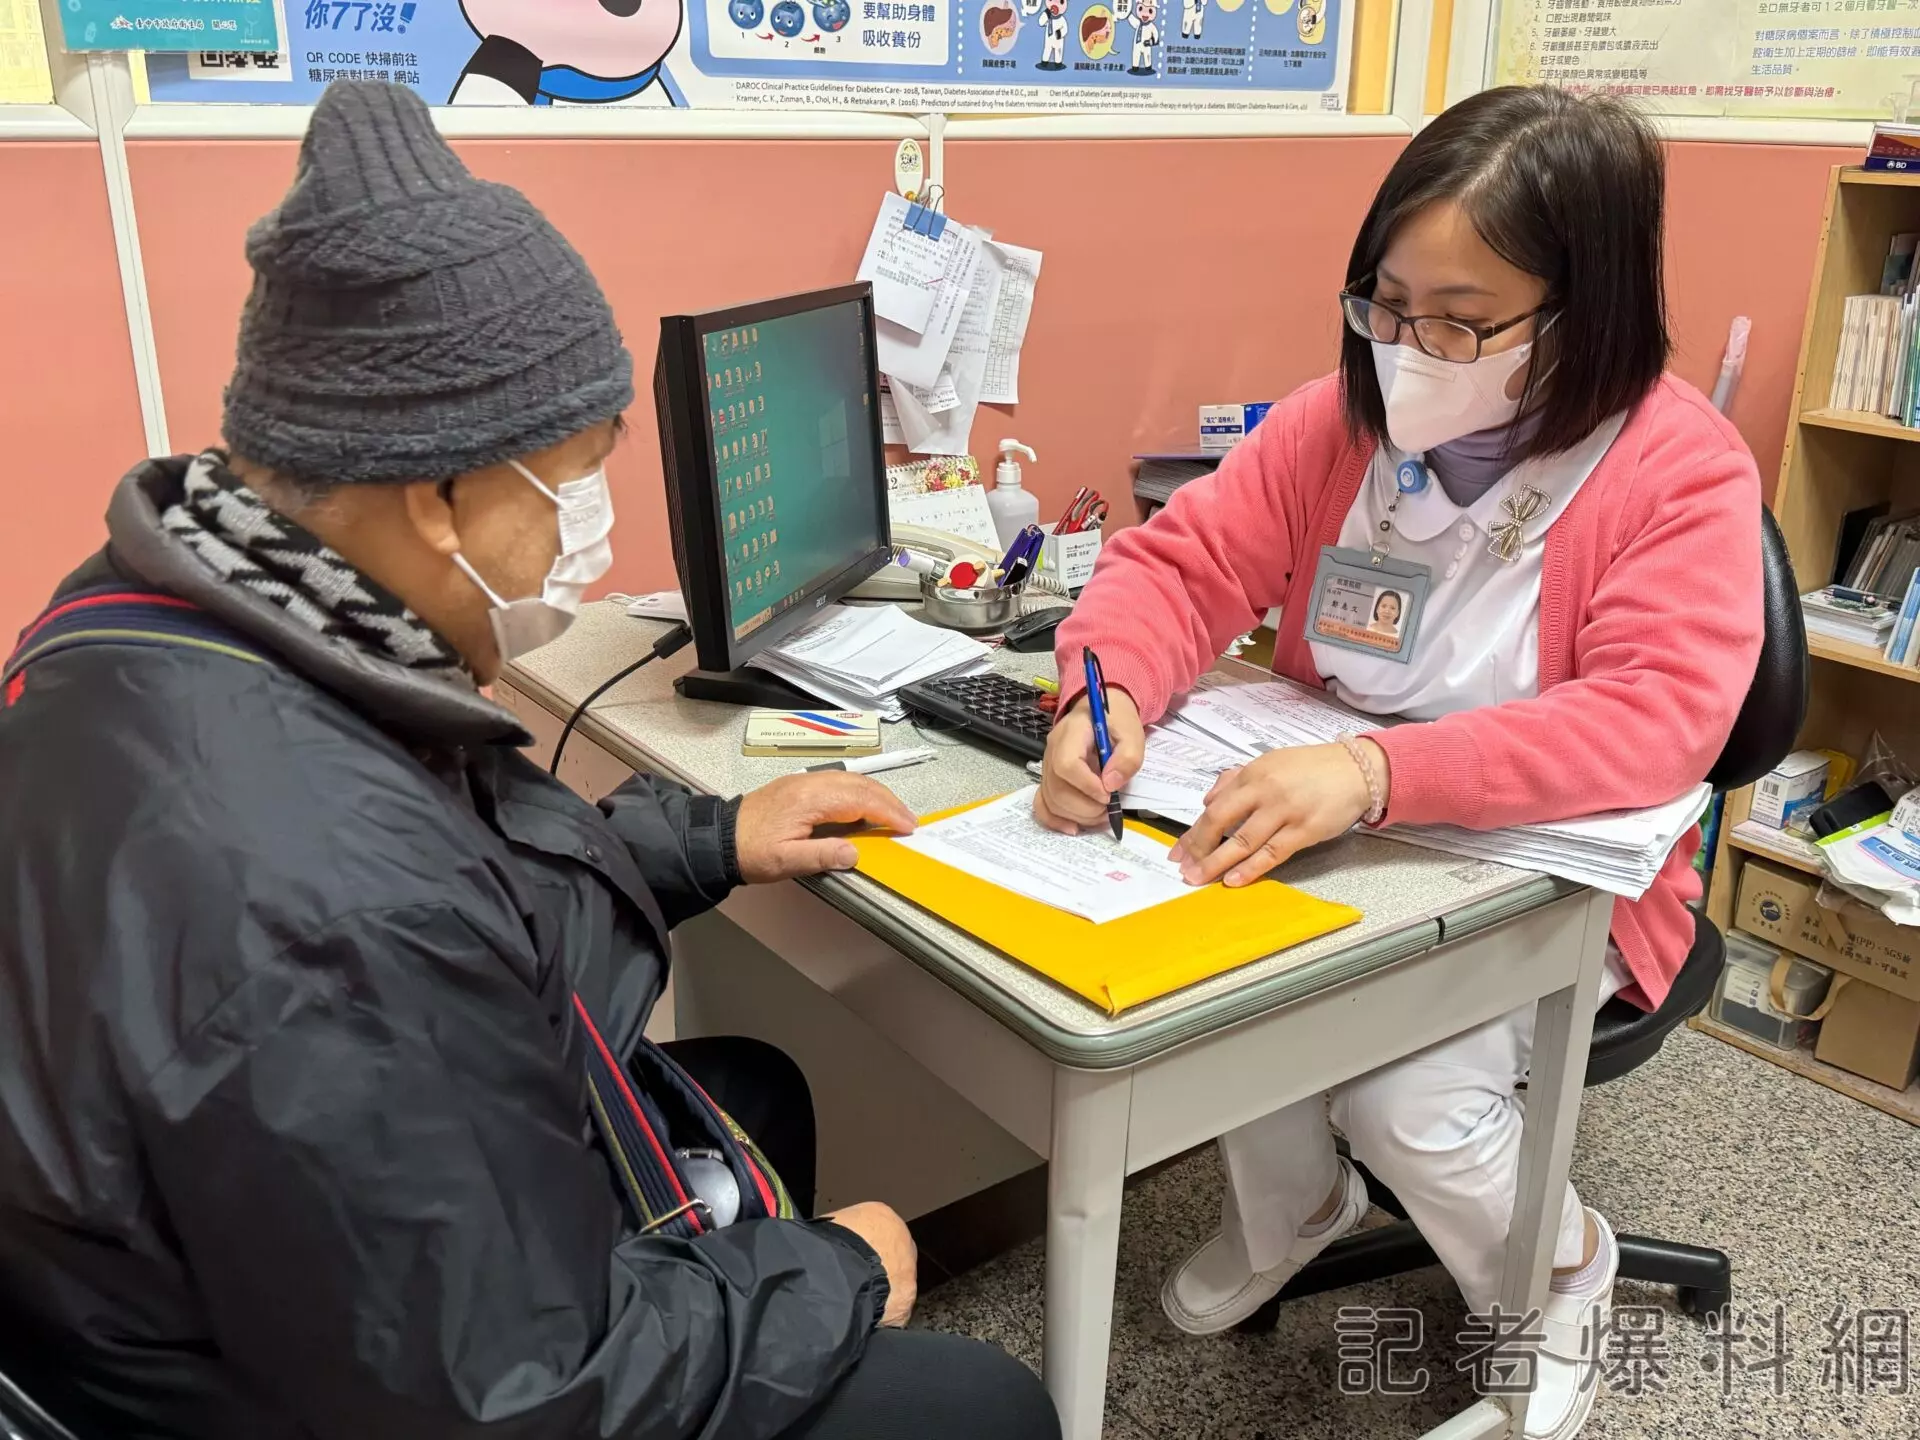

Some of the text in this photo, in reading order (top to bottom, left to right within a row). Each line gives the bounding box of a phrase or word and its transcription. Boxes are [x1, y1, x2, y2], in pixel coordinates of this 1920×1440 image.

[862, 2, 935, 22] 要幫助身體
[862, 29, 922, 49] 吸收養份
[306, 51, 418, 67] QR CODE 快掃前往
[393, 70, 420, 85] 網站
[735, 82, 761, 91] DAROC
[761, 82, 784, 91] Clinical
[784, 83, 810, 91] Practice
[810, 84, 844, 92] Guidelines
[845, 84, 855, 93] for
[856, 85, 884, 94] Diabetes
[903, 87, 920, 96] 2018,
[921, 87, 943, 97] Taiwan,
[944, 88, 967, 96] Diabetes
[967, 88, 995, 97] Association
[736, 94, 762, 104] Kramer,
[780, 96, 805, 105] Zinman,
[850, 97, 890, 107] Retnakaran,
[921, 99, 951, 107] Predictors
[957, 99, 981, 107] sustained
